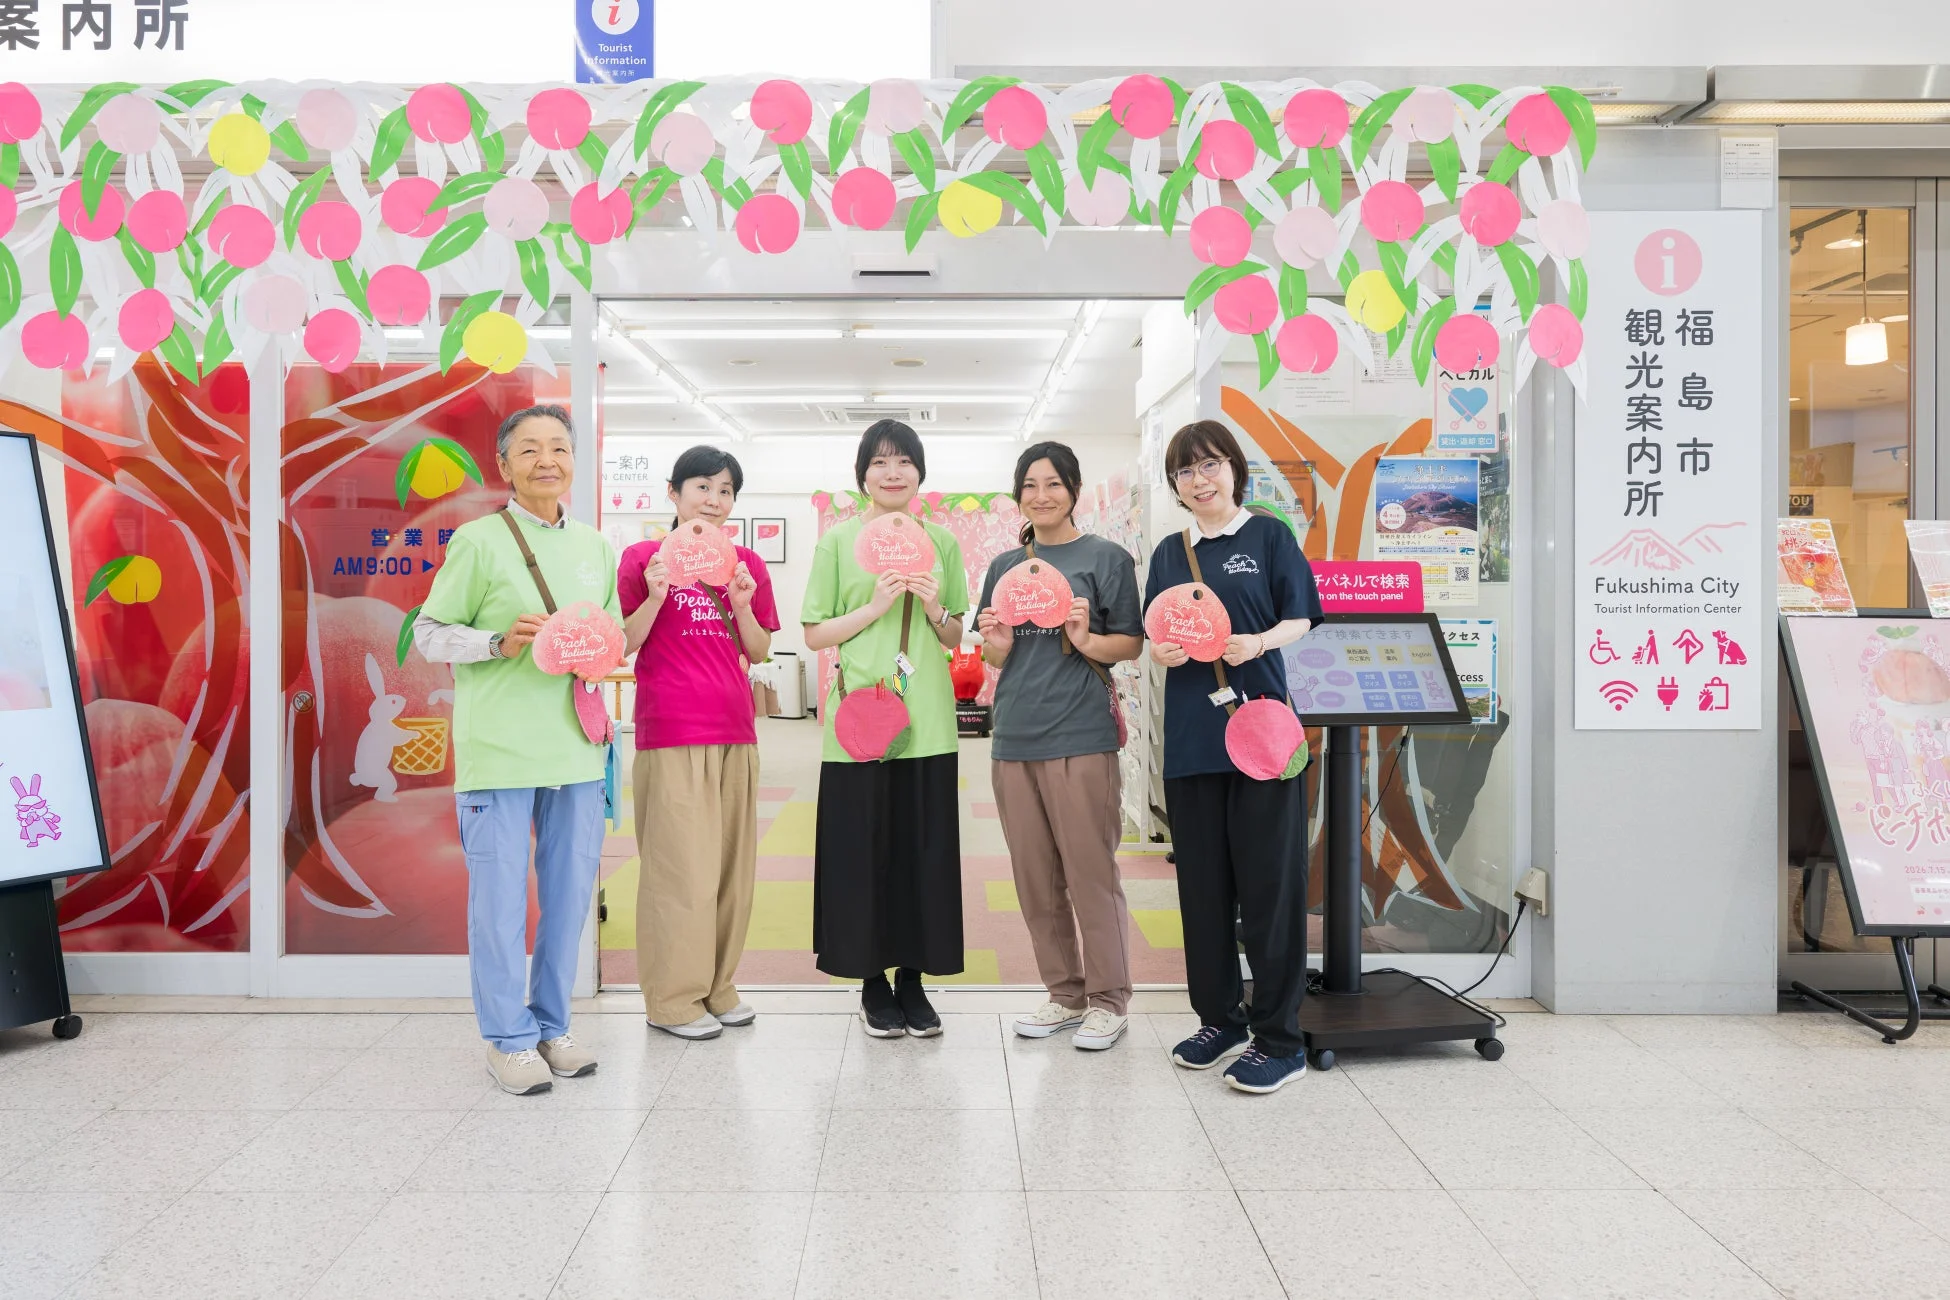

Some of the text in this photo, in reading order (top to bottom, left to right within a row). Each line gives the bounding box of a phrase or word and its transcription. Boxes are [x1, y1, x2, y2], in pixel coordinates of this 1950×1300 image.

[598, 43, 633, 53] Tourist
[1675, 308, 1714, 476] 福島市
[1624, 308, 1665, 517] 観光案内所
[612, 473, 648, 481] CENTER
[1789, 495, 1810, 506] OU
[871, 541, 902, 552] Peach
[674, 551, 705, 565] Peach
[879, 552, 910, 562] Holiday
[333, 556, 412, 576] AM9:00
[684, 560, 715, 572] Holiday
[1595, 577, 1740, 599] Fukushima City
[674, 592, 716, 611] Peac
[1008, 590, 1039, 603] Peach
[1339, 592, 1353, 600] the
[1354, 592, 1379, 600] touch
[1380, 592, 1404, 602] panel
[1016, 600, 1047, 611] Holiday
[1594, 603, 1742, 614] Tourist Information Center
[1163, 611, 1196, 628] Peach
[1169, 624, 1203, 640] Holiday
[553, 636, 588, 650] Peach
[561, 646, 596, 659] Holiday
